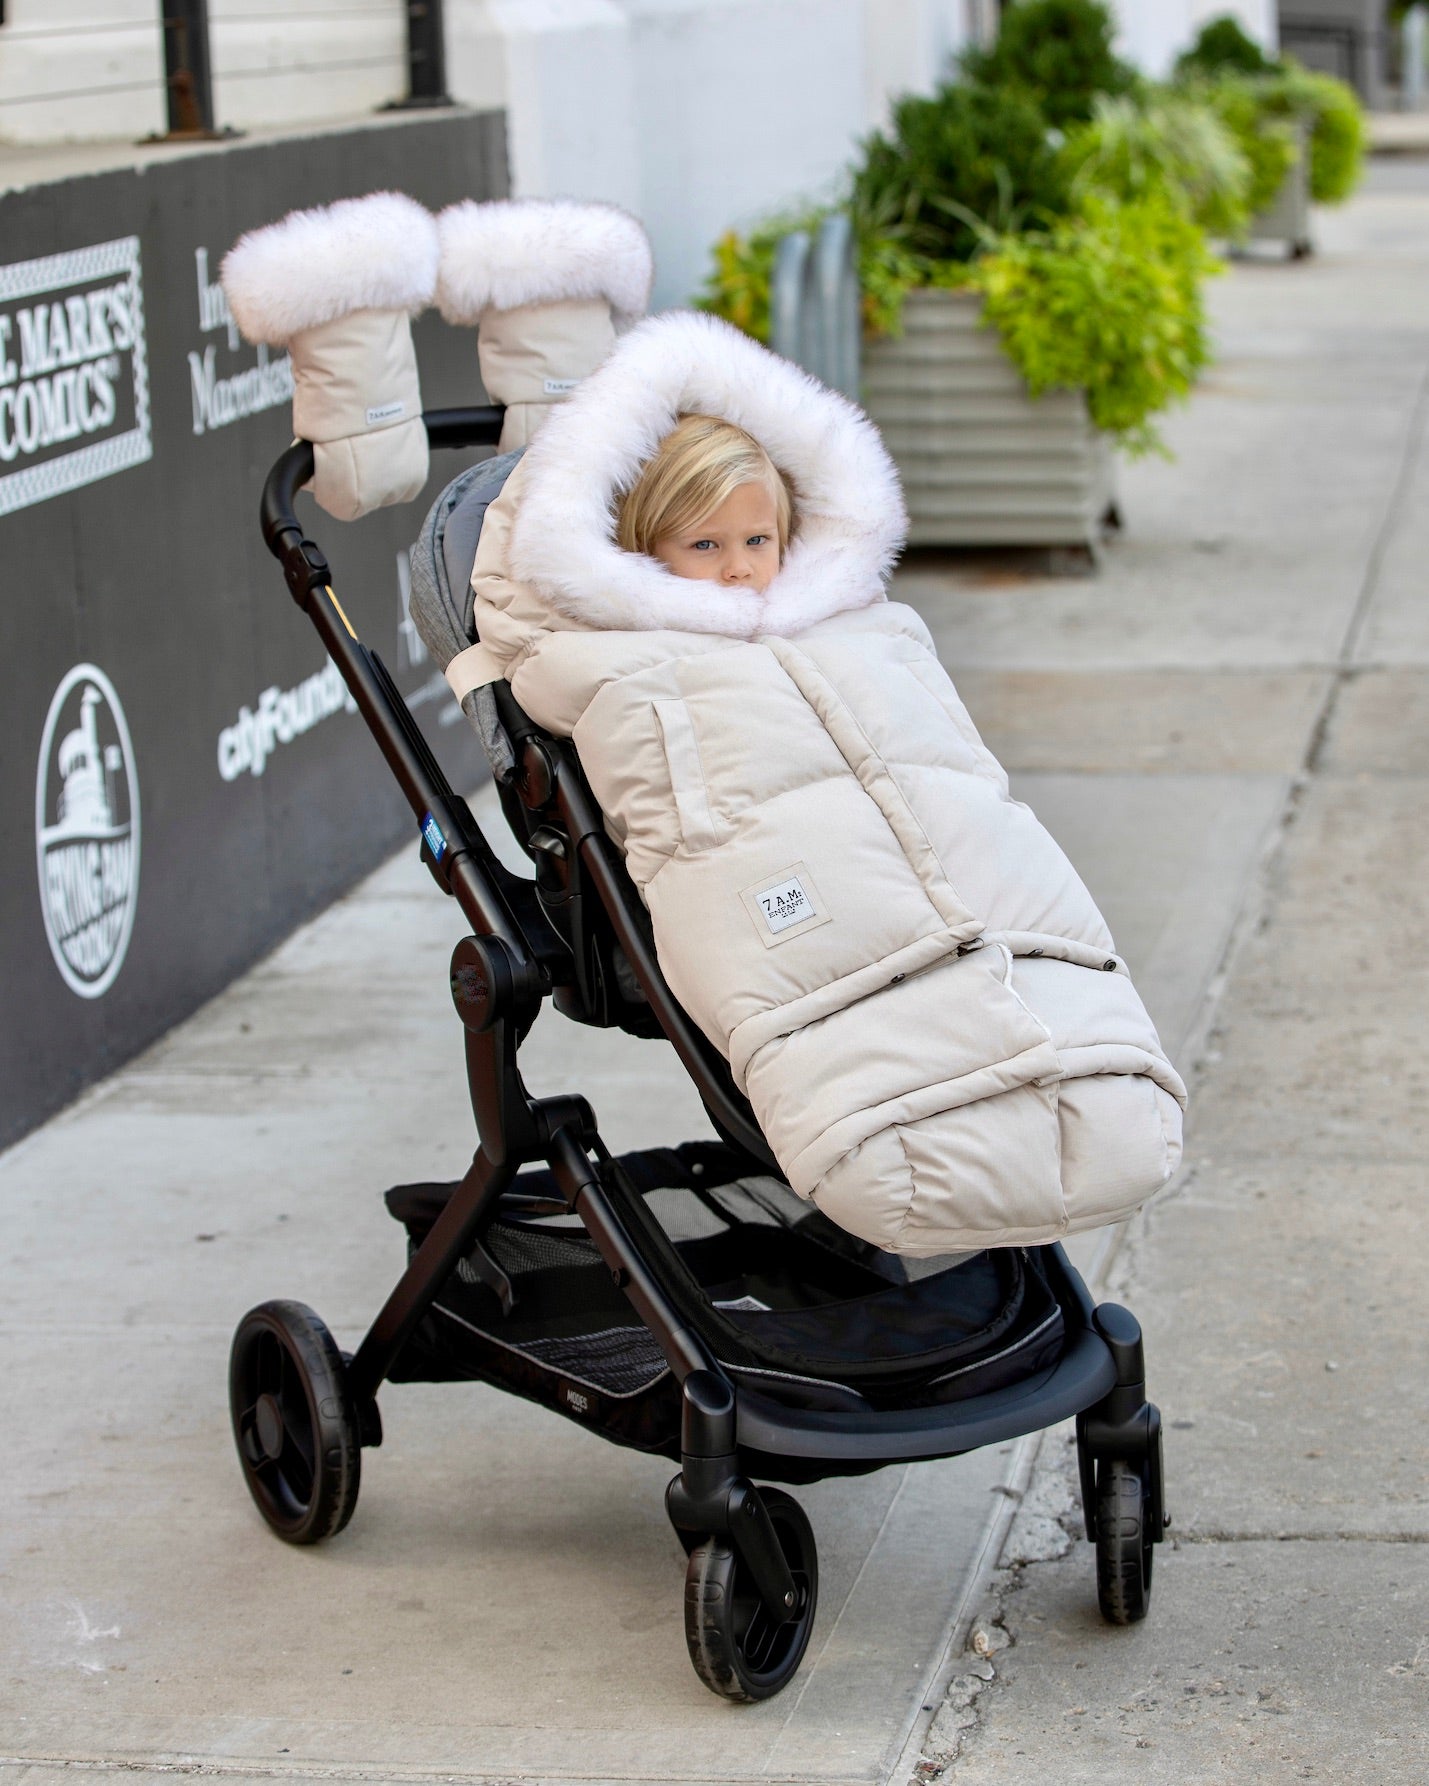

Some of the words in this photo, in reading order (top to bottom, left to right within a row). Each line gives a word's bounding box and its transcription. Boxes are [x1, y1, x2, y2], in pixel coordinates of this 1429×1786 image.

[0, 357, 117, 461] COMICS
[762, 898, 771, 912] 7
[768, 898, 804, 919] ENFANT
